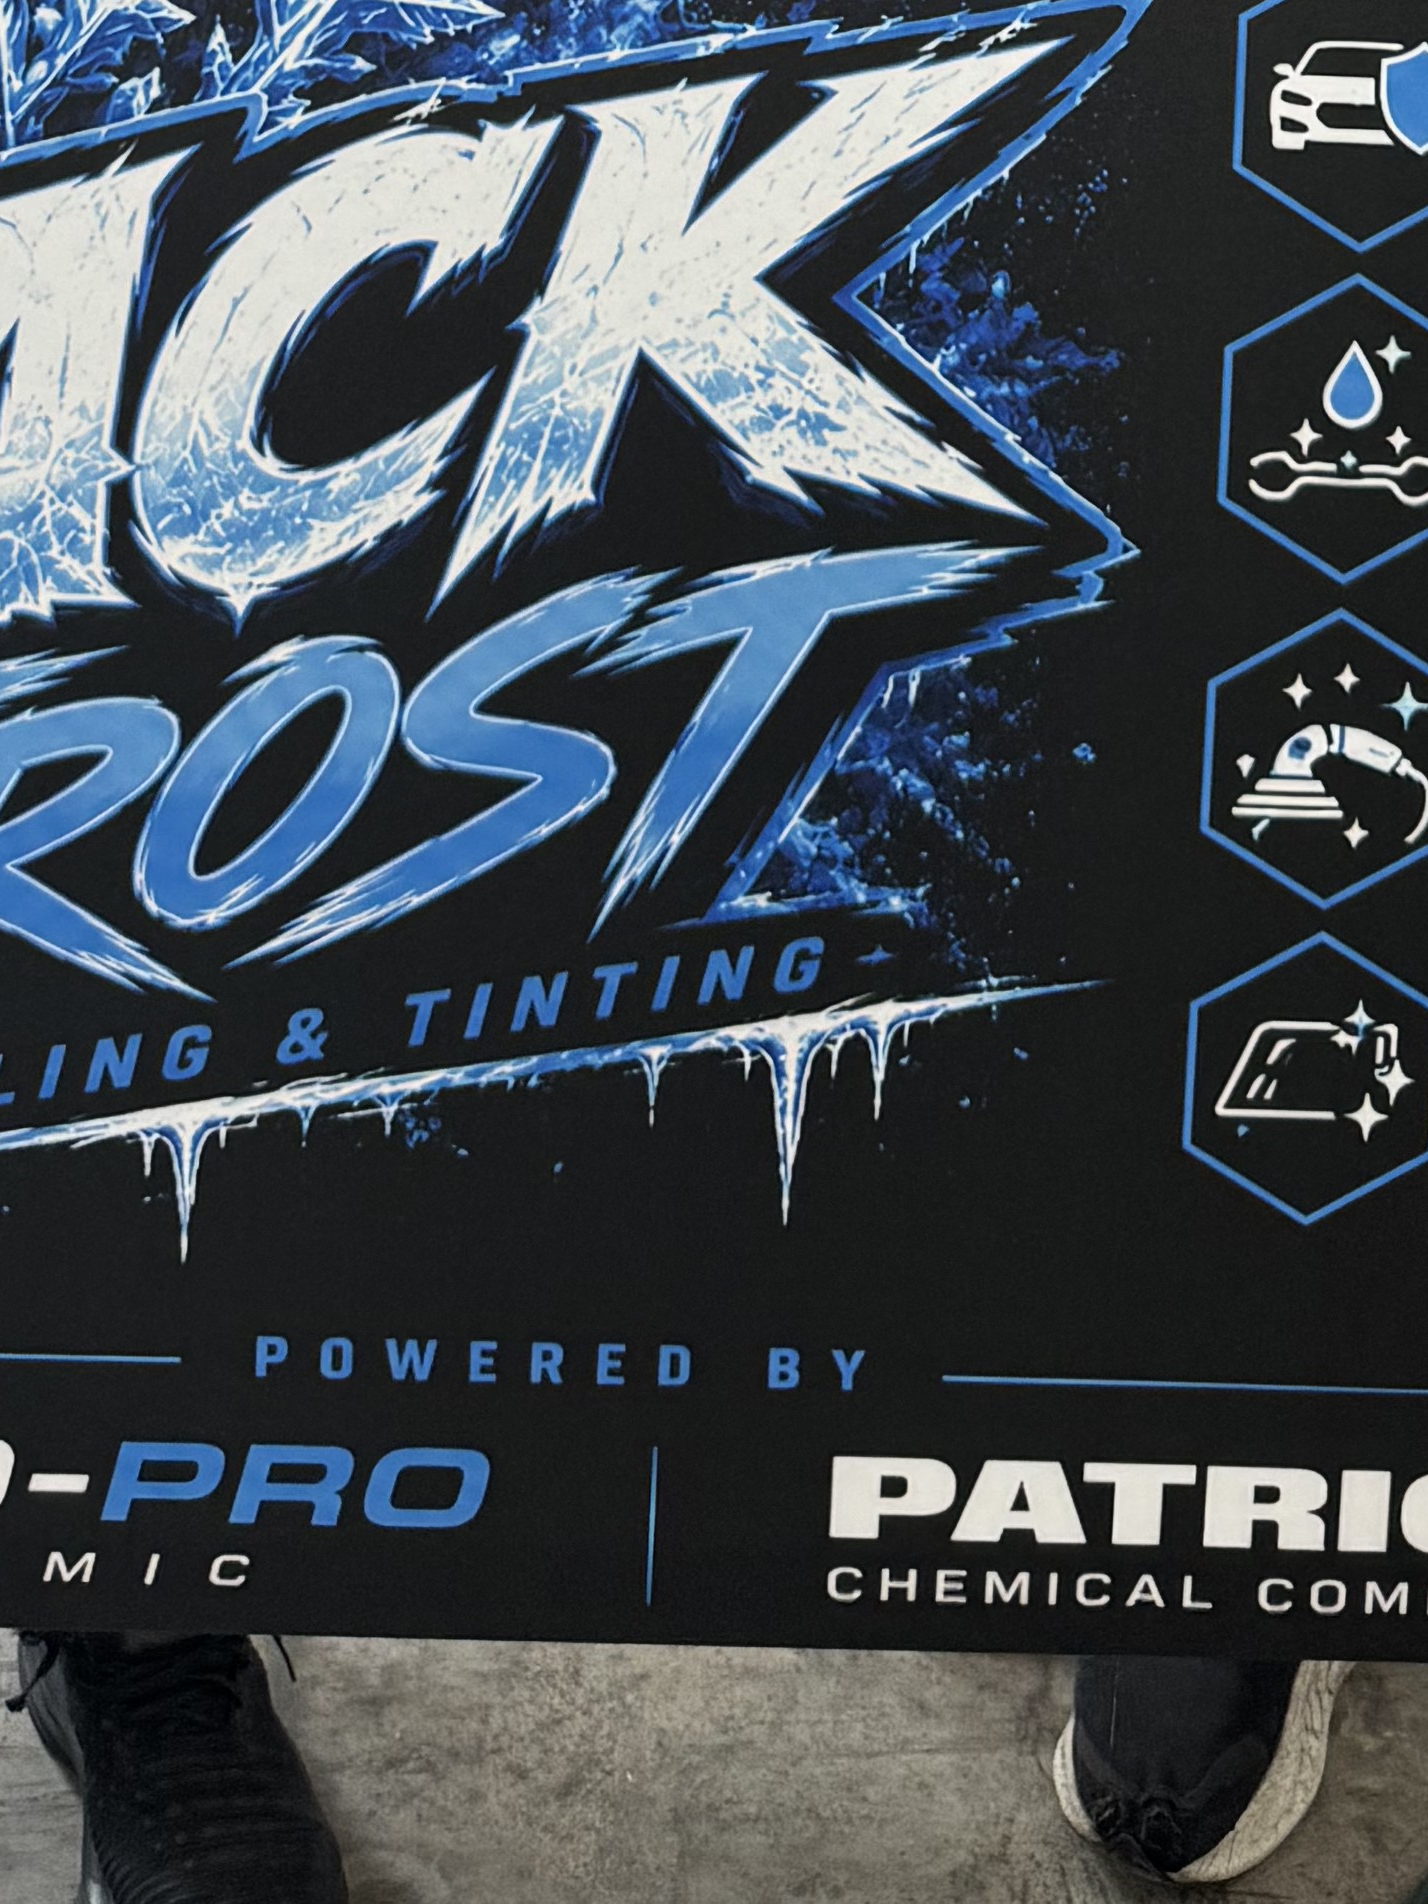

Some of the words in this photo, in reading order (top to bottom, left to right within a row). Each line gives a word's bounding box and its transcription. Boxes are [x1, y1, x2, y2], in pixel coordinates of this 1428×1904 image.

[275, 1007, 330, 1066] &
[402, 935, 829, 1050] TINTING
[253, 1333, 694, 1389] POWERED
[767, 1347, 868, 1392] BY
[825, 1564, 1215, 1612] CHEMICAL
